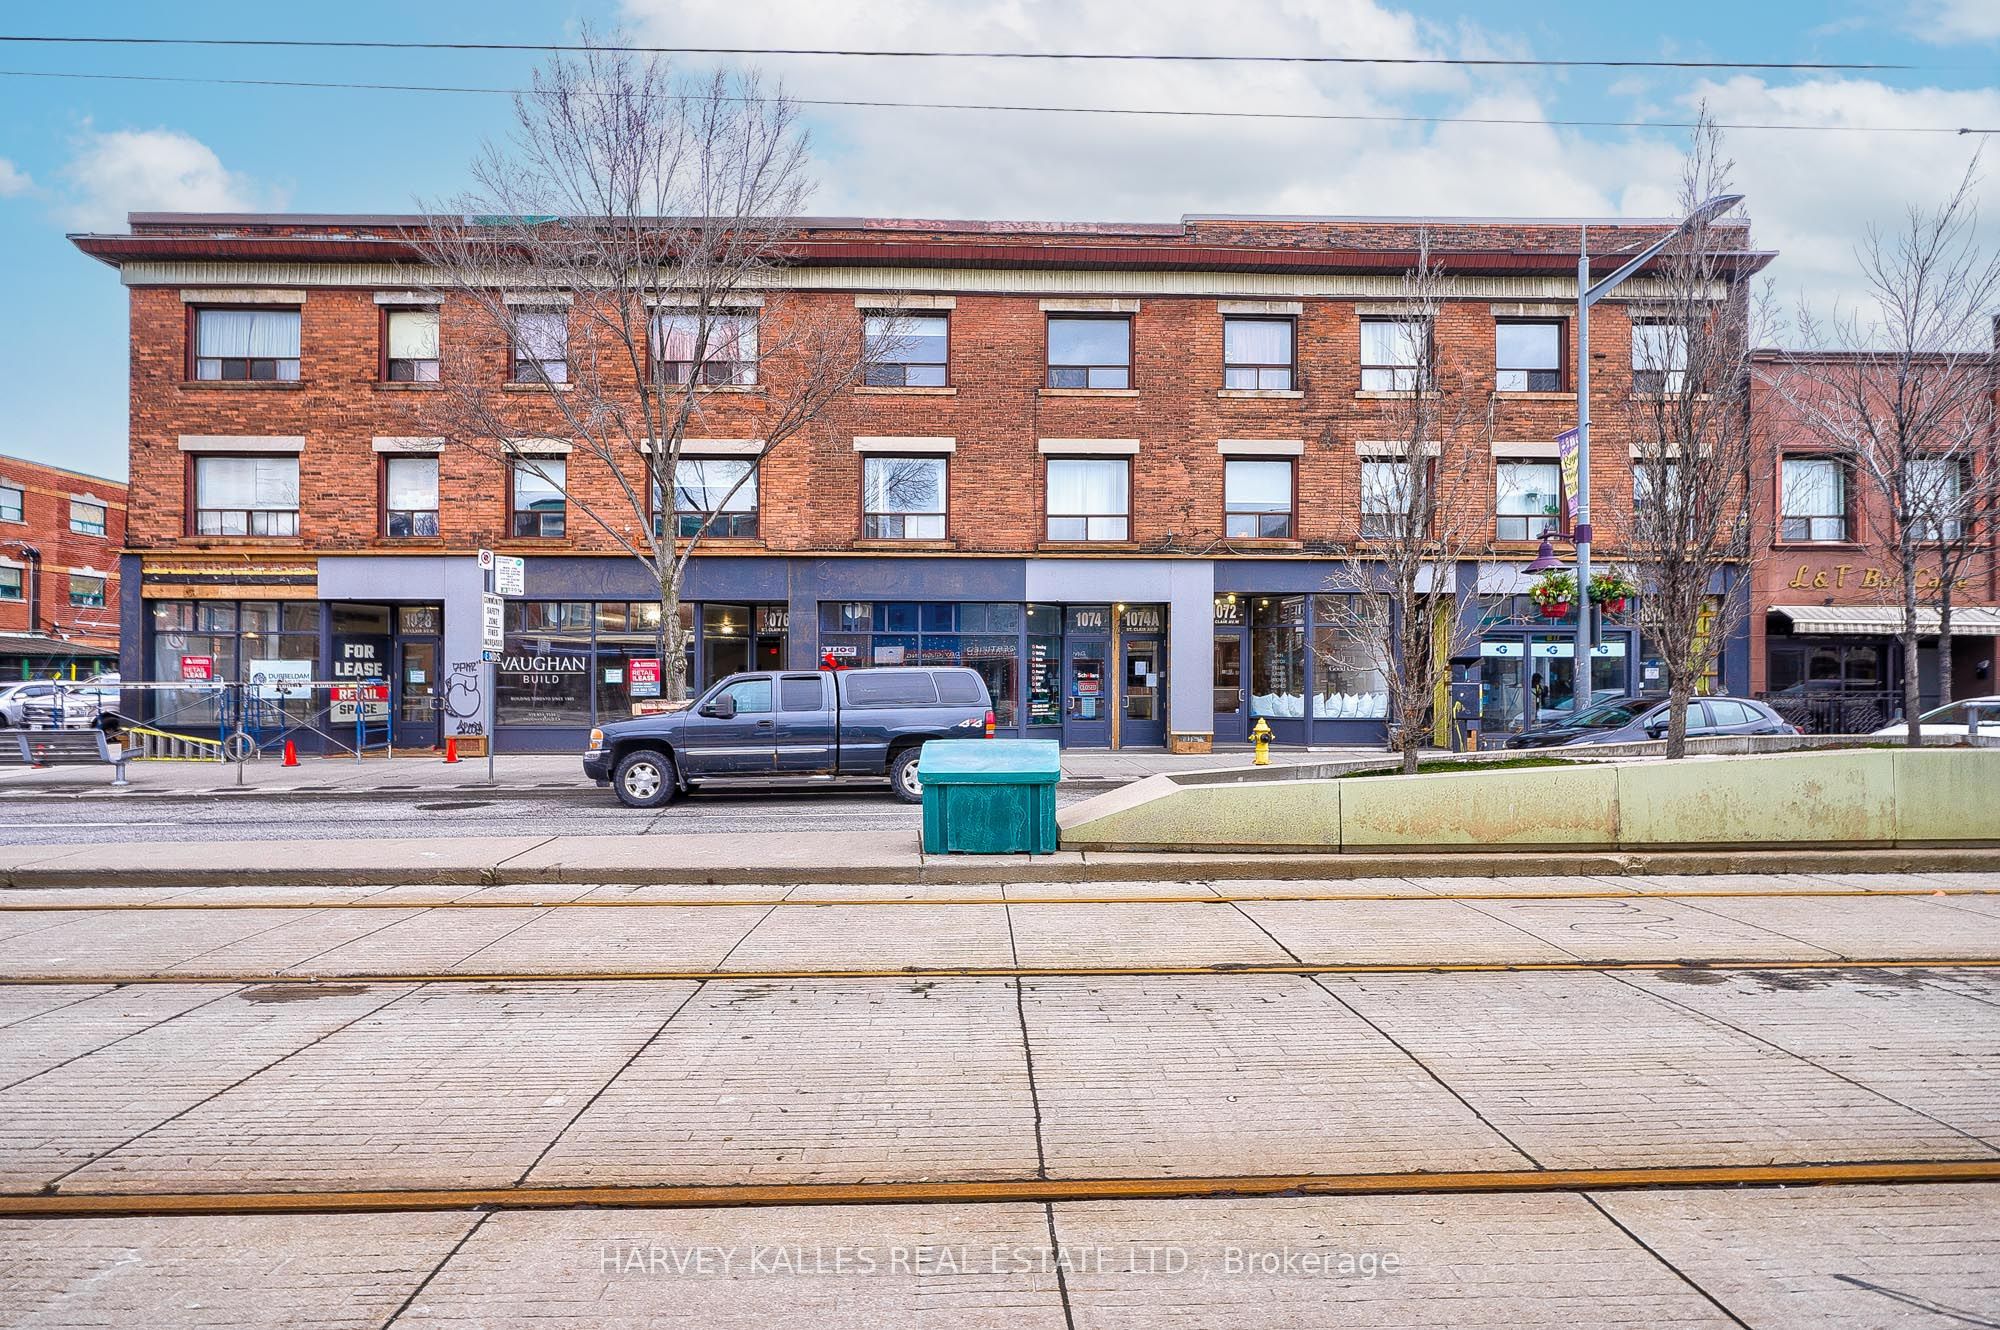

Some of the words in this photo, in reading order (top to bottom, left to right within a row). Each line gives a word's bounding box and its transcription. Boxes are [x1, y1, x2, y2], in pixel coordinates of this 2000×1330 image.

[1788, 564, 1809, 589] L
[1812, 570, 1829, 590] &
[1914, 566, 1968, 589] Cae
[486, 606, 500, 615] SAFETY
[1213, 604, 1236, 618] 072
[488, 617, 498, 626] ZONE
[1076, 612, 1102, 626] 1074
[1125, 612, 1160, 626] 1074A
[344, 644, 374, 658] FOR
[335, 661, 382, 676] LEASE
[500, 656, 586, 671] VAUGHAN
[523, 675, 560, 684] BUILD
